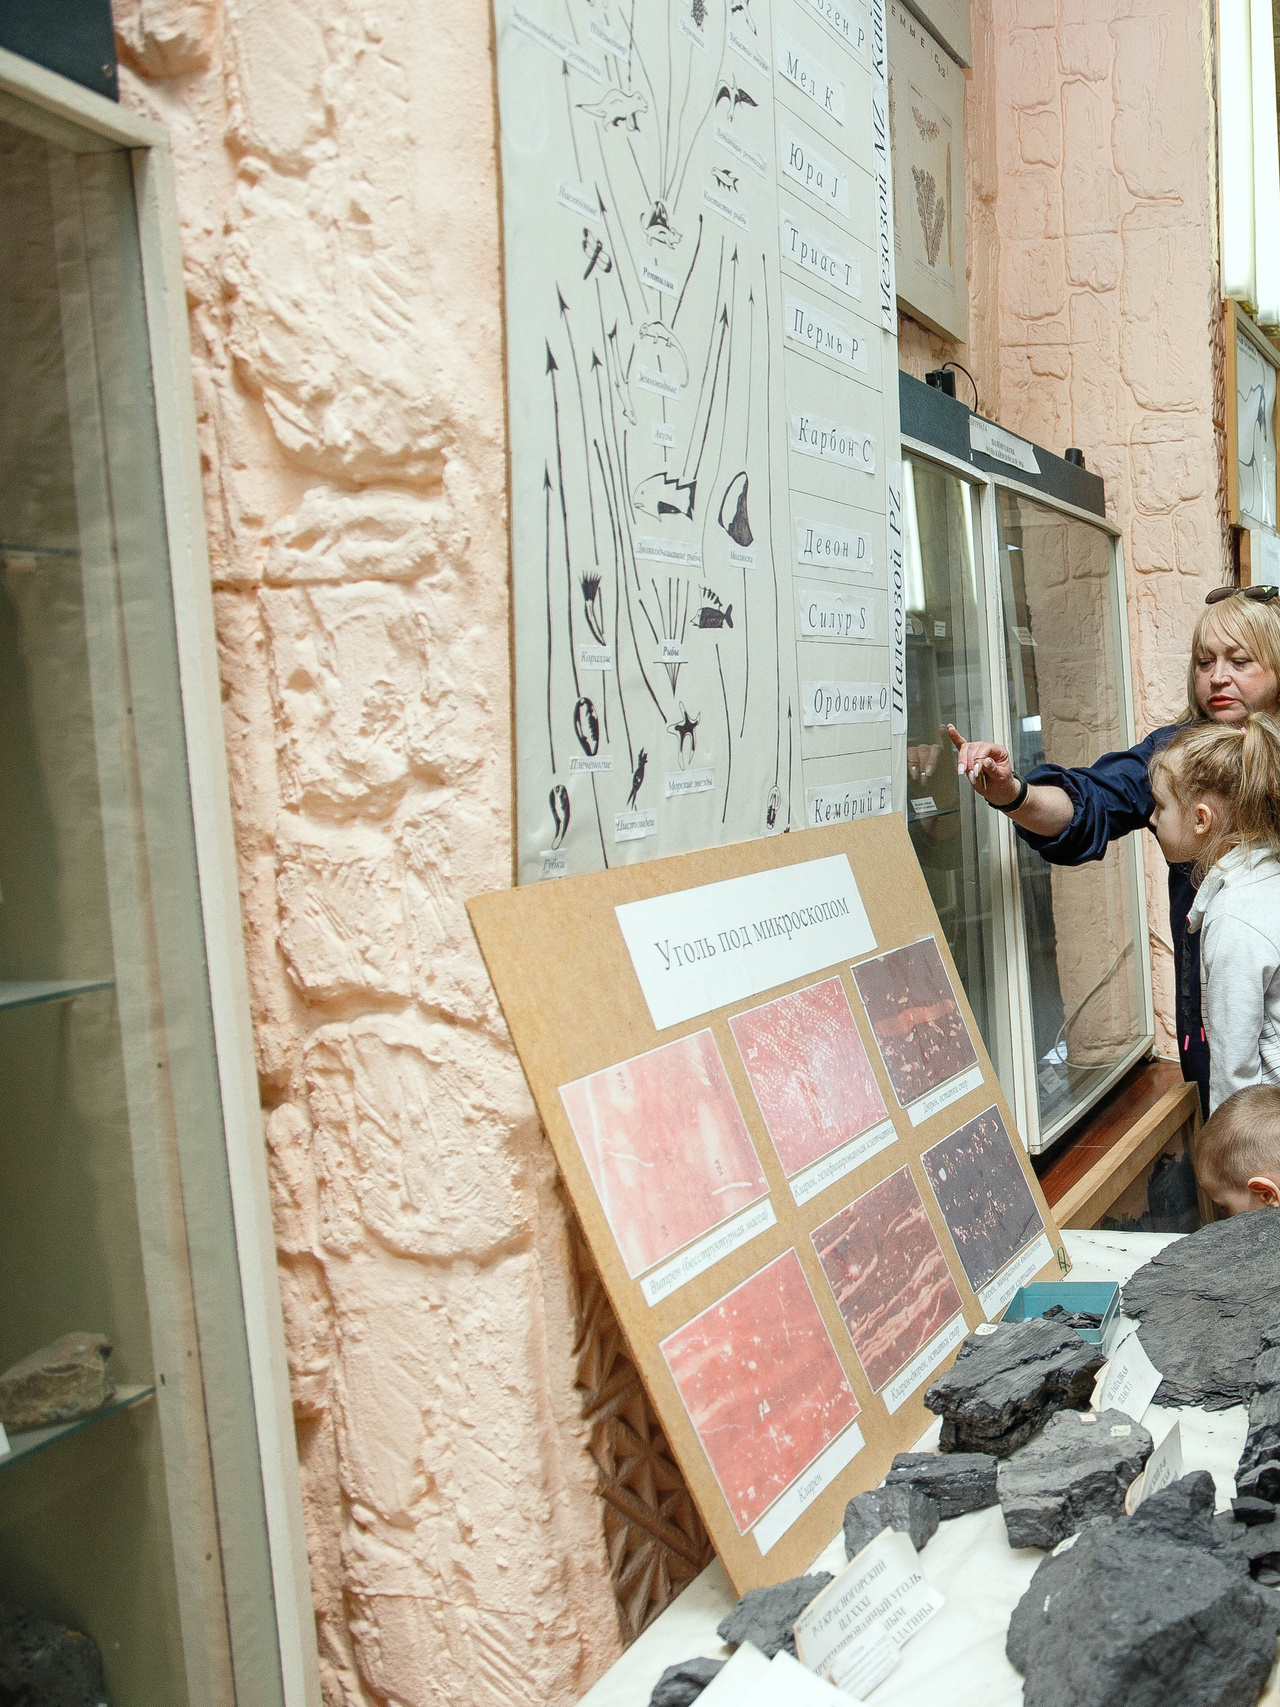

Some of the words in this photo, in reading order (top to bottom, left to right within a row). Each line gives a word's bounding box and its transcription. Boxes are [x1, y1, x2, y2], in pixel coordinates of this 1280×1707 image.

[786, 51, 816, 96] Мел
[789, 142, 824, 185] Юра
[831, 177, 839, 199] J
[790, 227, 837, 277] Триас
[874, 167, 893, 324] Мезозой
[642, 266, 674, 290] Рептилии
[794, 308, 843, 354] Пермь
[638, 371, 677, 395] Земноводные
[798, 417, 854, 457] Карбон
[803, 528, 849, 559] Девон
[857, 536, 865, 559] D
[808, 603, 852, 636] Силур
[860, 606, 866, 630] S
[889, 548, 904, 717] Палеозой
[580, 650, 611, 664] Кораллы
[662, 645, 680, 658] Рыбы
[814, 688, 873, 720] Ордовик
[570, 758, 612, 771] Плеченогие
[668, 779, 692, 792] Морские
[814, 790, 873, 824] Кембрий
[542, 857, 565, 872] Губки
[654, 936, 716, 971] Уголь
[717, 926, 754, 953] под
[752, 897, 850, 941] микроскопом
[649, 1268, 681, 1295] Витрен
[682, 1225, 745, 1272] (бесструктурная
[745, 1207, 769, 1233] масса)
[797, 1473, 823, 1503] Кларен
[820, 1558, 888, 1626] КРАСНОГОРСКИЙ
[890, 1572, 922, 1603] УГОЛЬ
[882, 1605, 907, 1632] НЫМ
